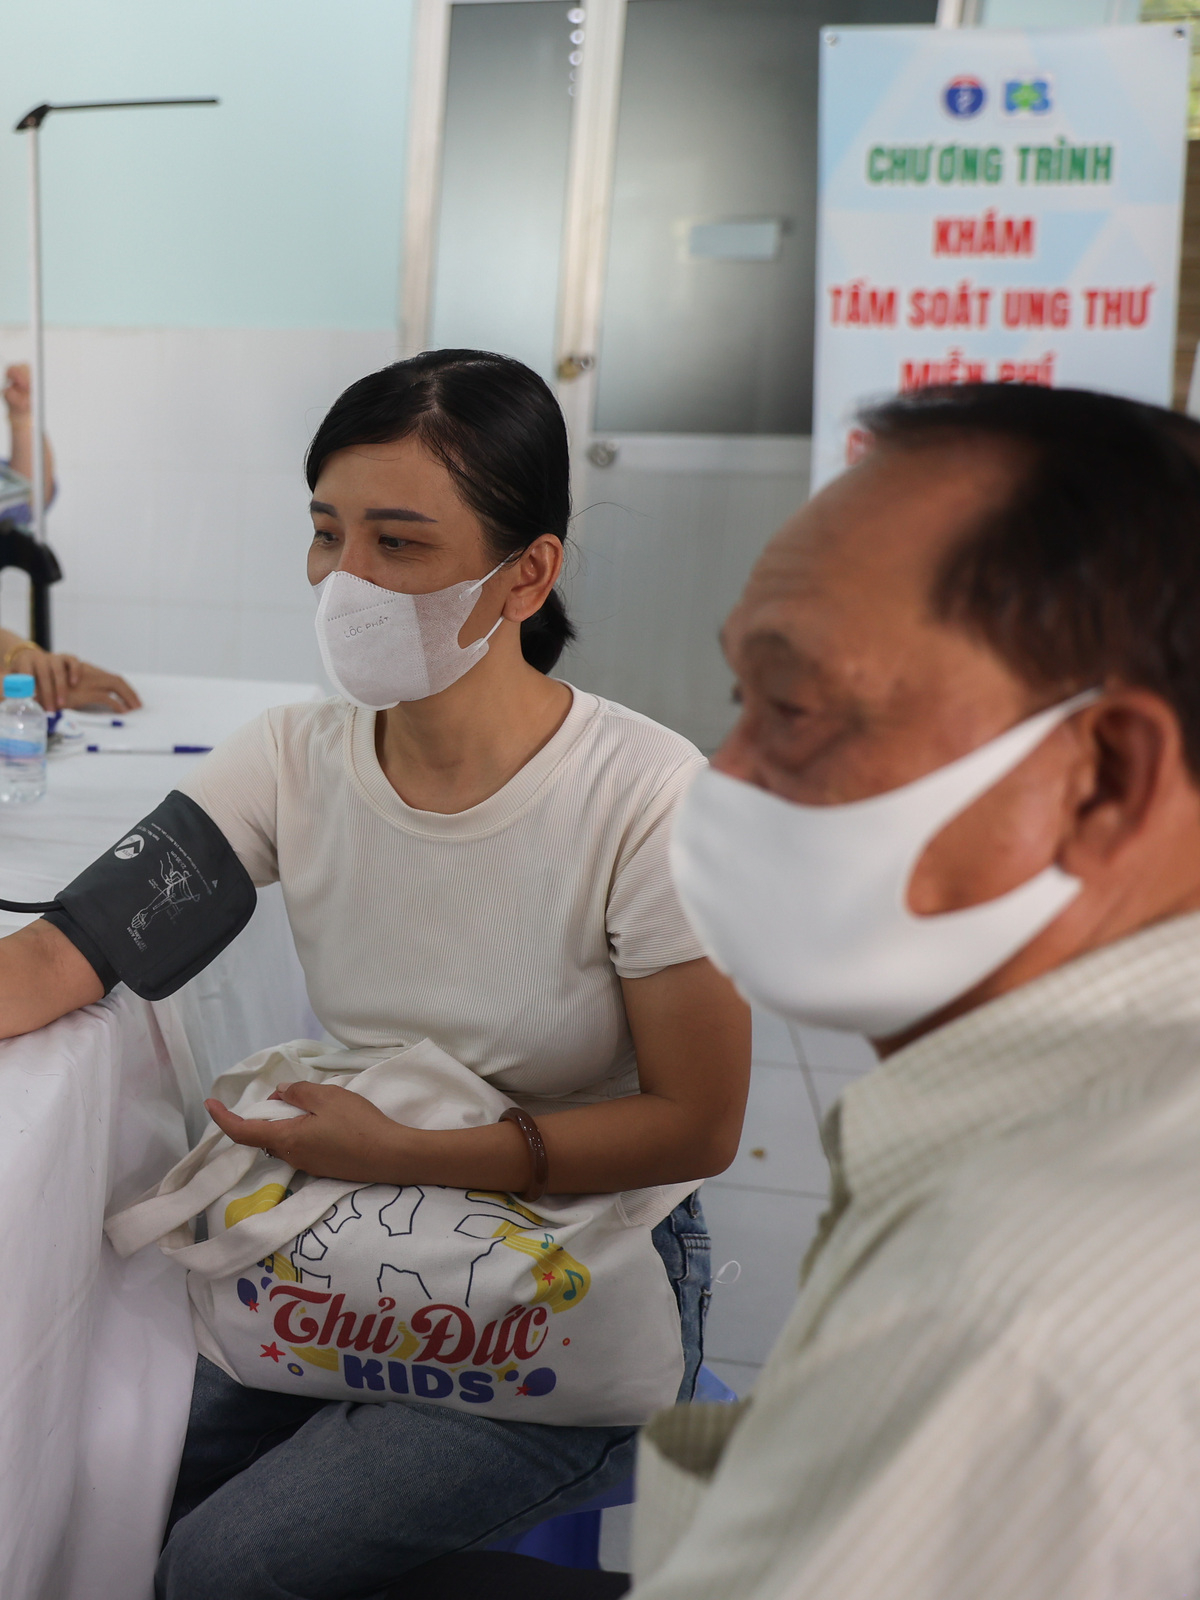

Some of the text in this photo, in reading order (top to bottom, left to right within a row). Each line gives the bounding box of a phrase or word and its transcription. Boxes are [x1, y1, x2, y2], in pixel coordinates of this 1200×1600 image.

[866, 137, 1113, 184] CHƯƠNG TRÌNH
[932, 207, 1035, 258] KHÁM
[906, 280, 992, 329] SOÁT
[1003, 289, 1071, 329] UNG
[1081, 283, 1155, 329] THƯ
[269, 1285, 549, 1366] Thủ Đức
[343, 1354, 494, 1403] KIDS
